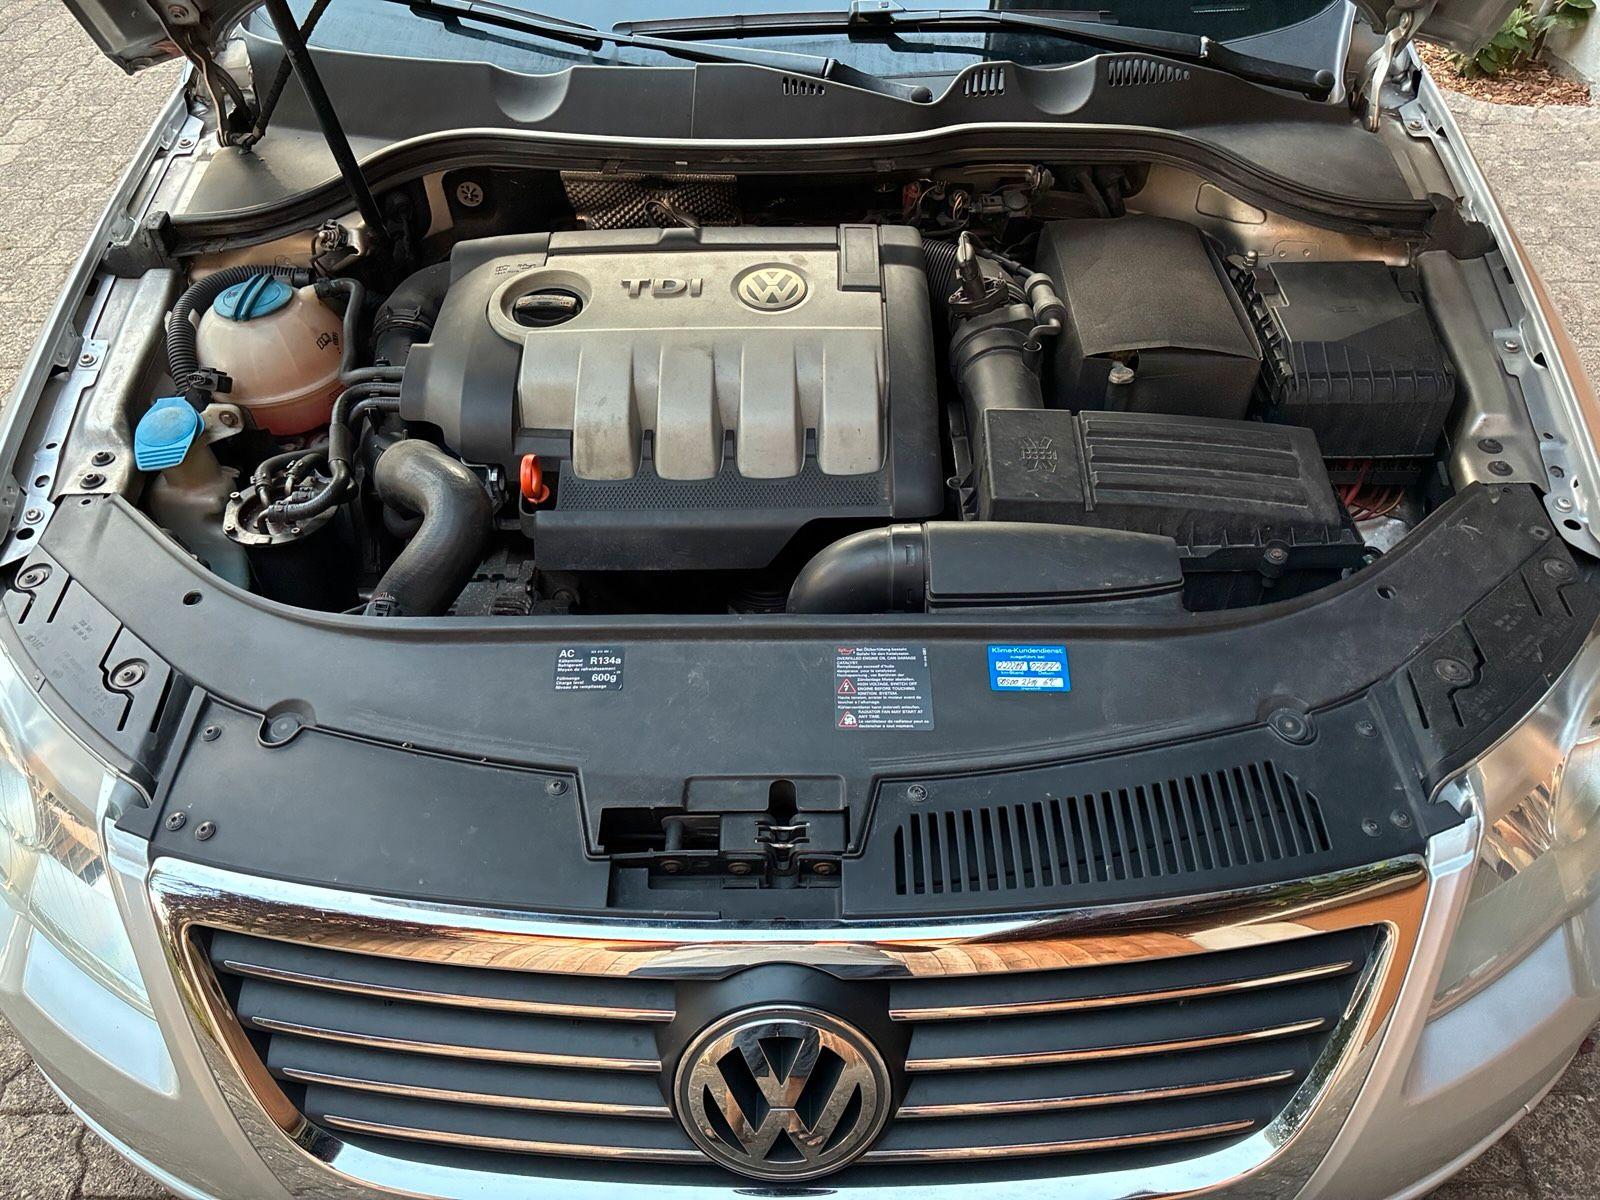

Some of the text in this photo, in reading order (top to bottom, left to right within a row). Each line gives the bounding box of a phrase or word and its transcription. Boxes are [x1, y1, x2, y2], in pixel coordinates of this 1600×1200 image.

[621, 278, 704, 298] TDI
[559, 649, 575, 657] AC
[592, 674, 616, 682] 600g
